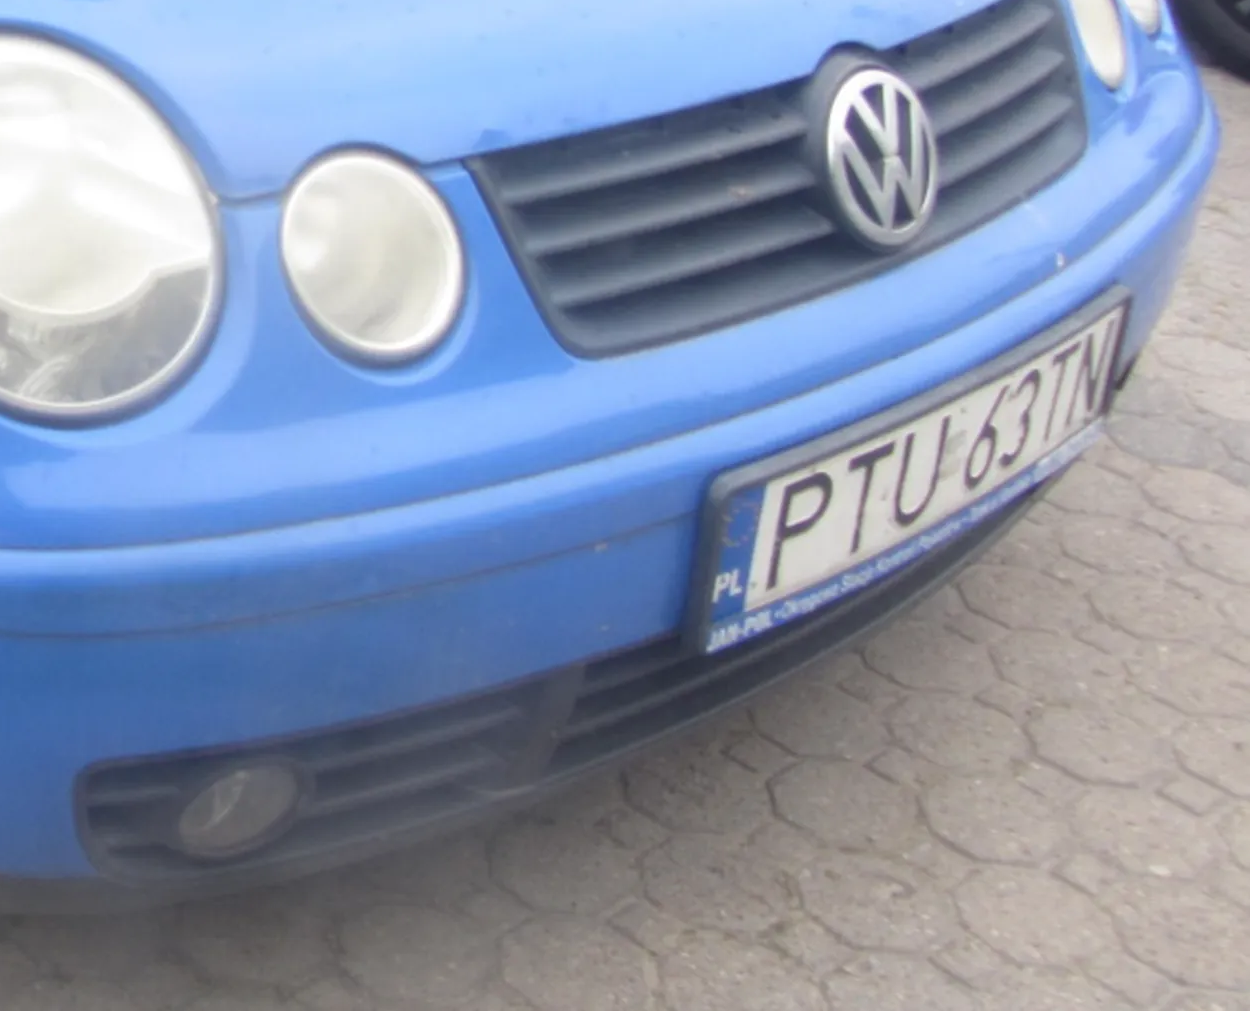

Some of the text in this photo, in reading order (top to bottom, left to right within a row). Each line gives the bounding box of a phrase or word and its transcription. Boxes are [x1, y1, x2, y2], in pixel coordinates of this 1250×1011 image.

[765, 318, 1116, 591] PTU 63TN
[712, 568, 742, 604] PL
